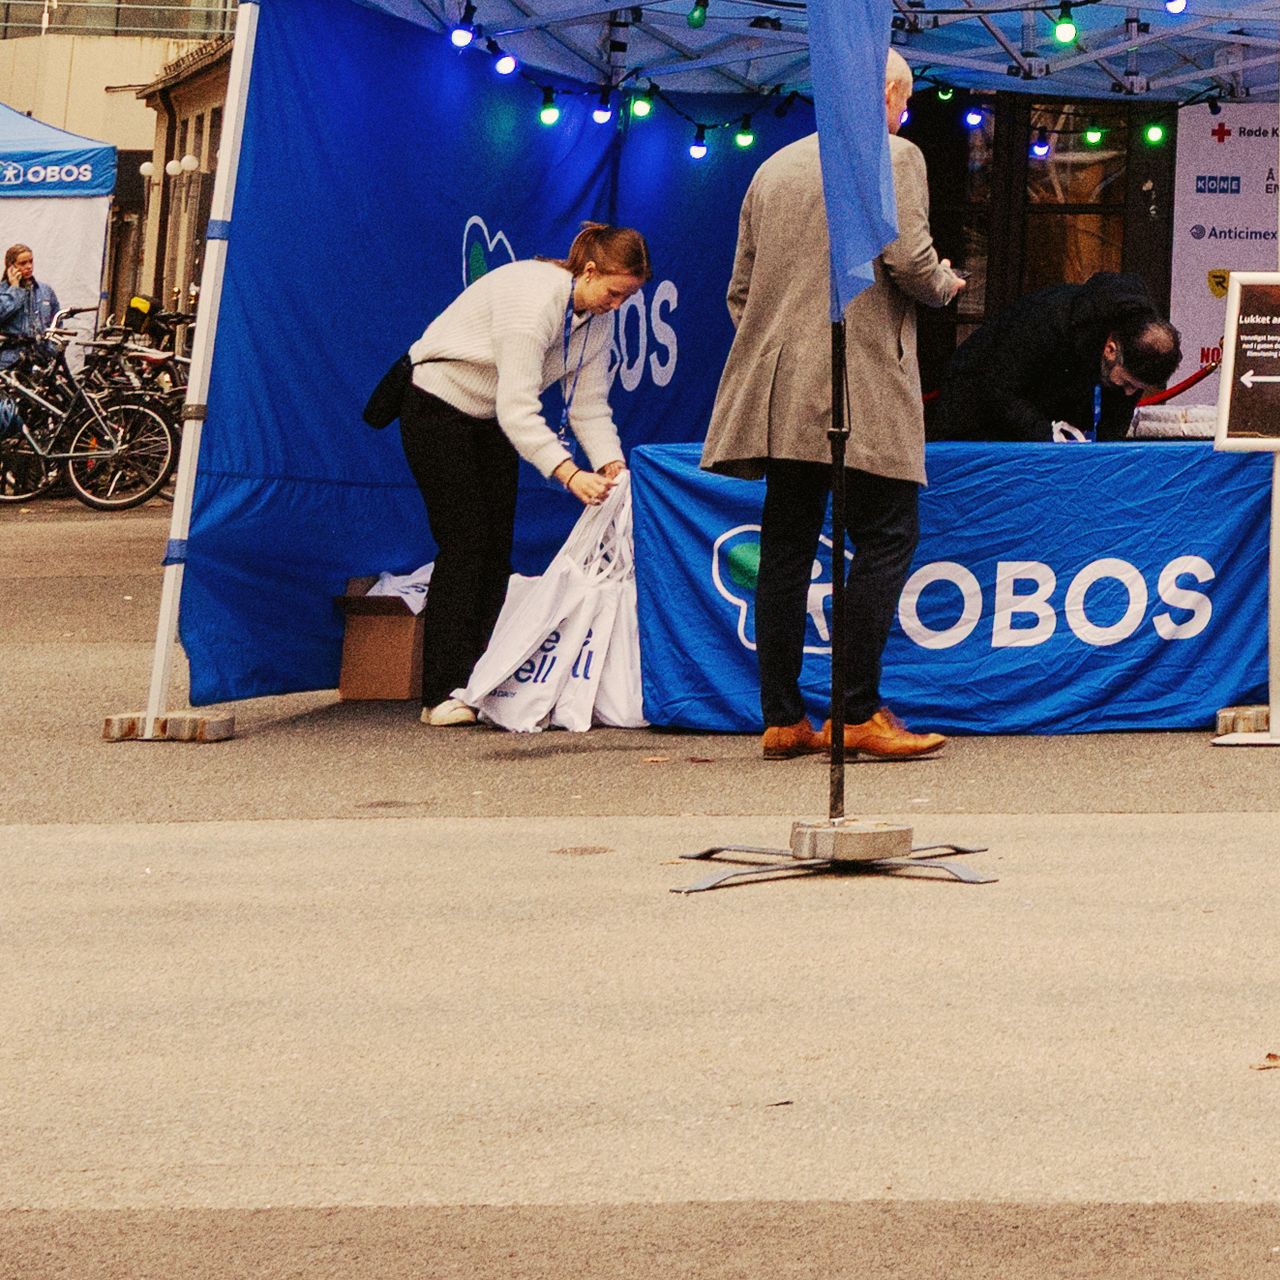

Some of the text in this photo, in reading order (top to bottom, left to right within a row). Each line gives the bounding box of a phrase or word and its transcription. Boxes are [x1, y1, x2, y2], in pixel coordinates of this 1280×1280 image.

[1239, 126, 1268, 137] Røde
[27, 163, 93, 183] OBOS
[1196, 180, 1240, 191] KONE
[1207, 225, 1277, 241] Anticimex
[1239, 314, 1270, 325] Lukket
[898, 555, 1213, 650] OBOS
